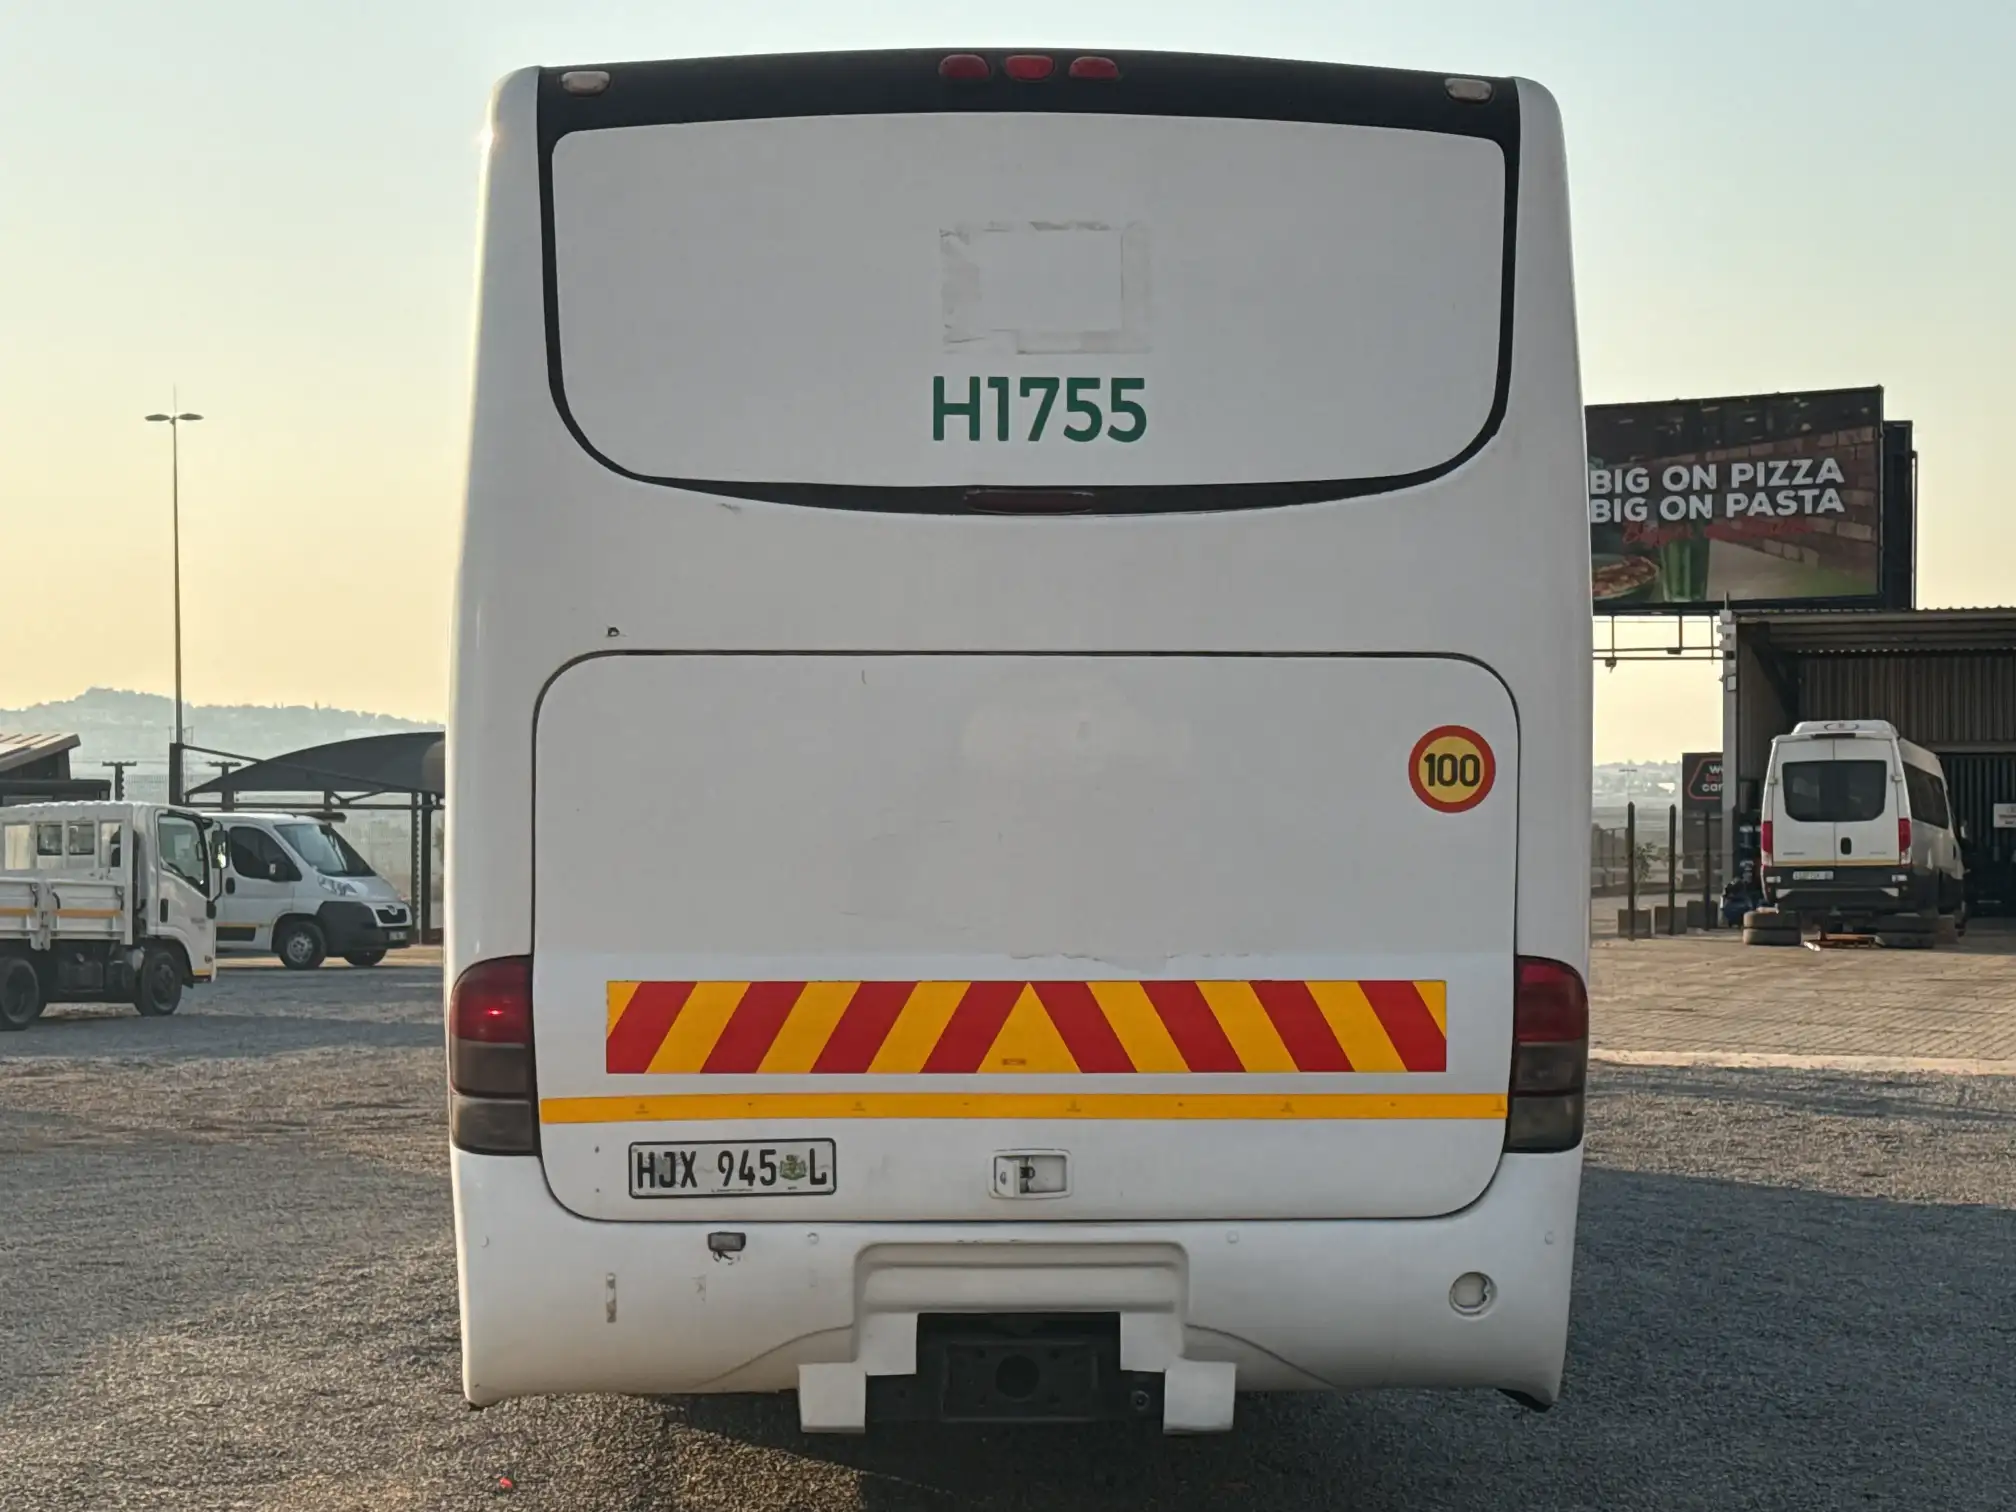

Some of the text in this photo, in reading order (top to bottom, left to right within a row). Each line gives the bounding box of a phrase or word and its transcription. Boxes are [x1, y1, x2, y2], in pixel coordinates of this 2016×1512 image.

[933, 376, 1147, 443] H1755
[1590, 457, 1845, 495] BIG ON PIZZA
[1590, 488, 1845, 524] BIG ON PASTA
[1424, 753, 1480, 787] 100
[637, 1148, 827, 1189] HJX 945 L
